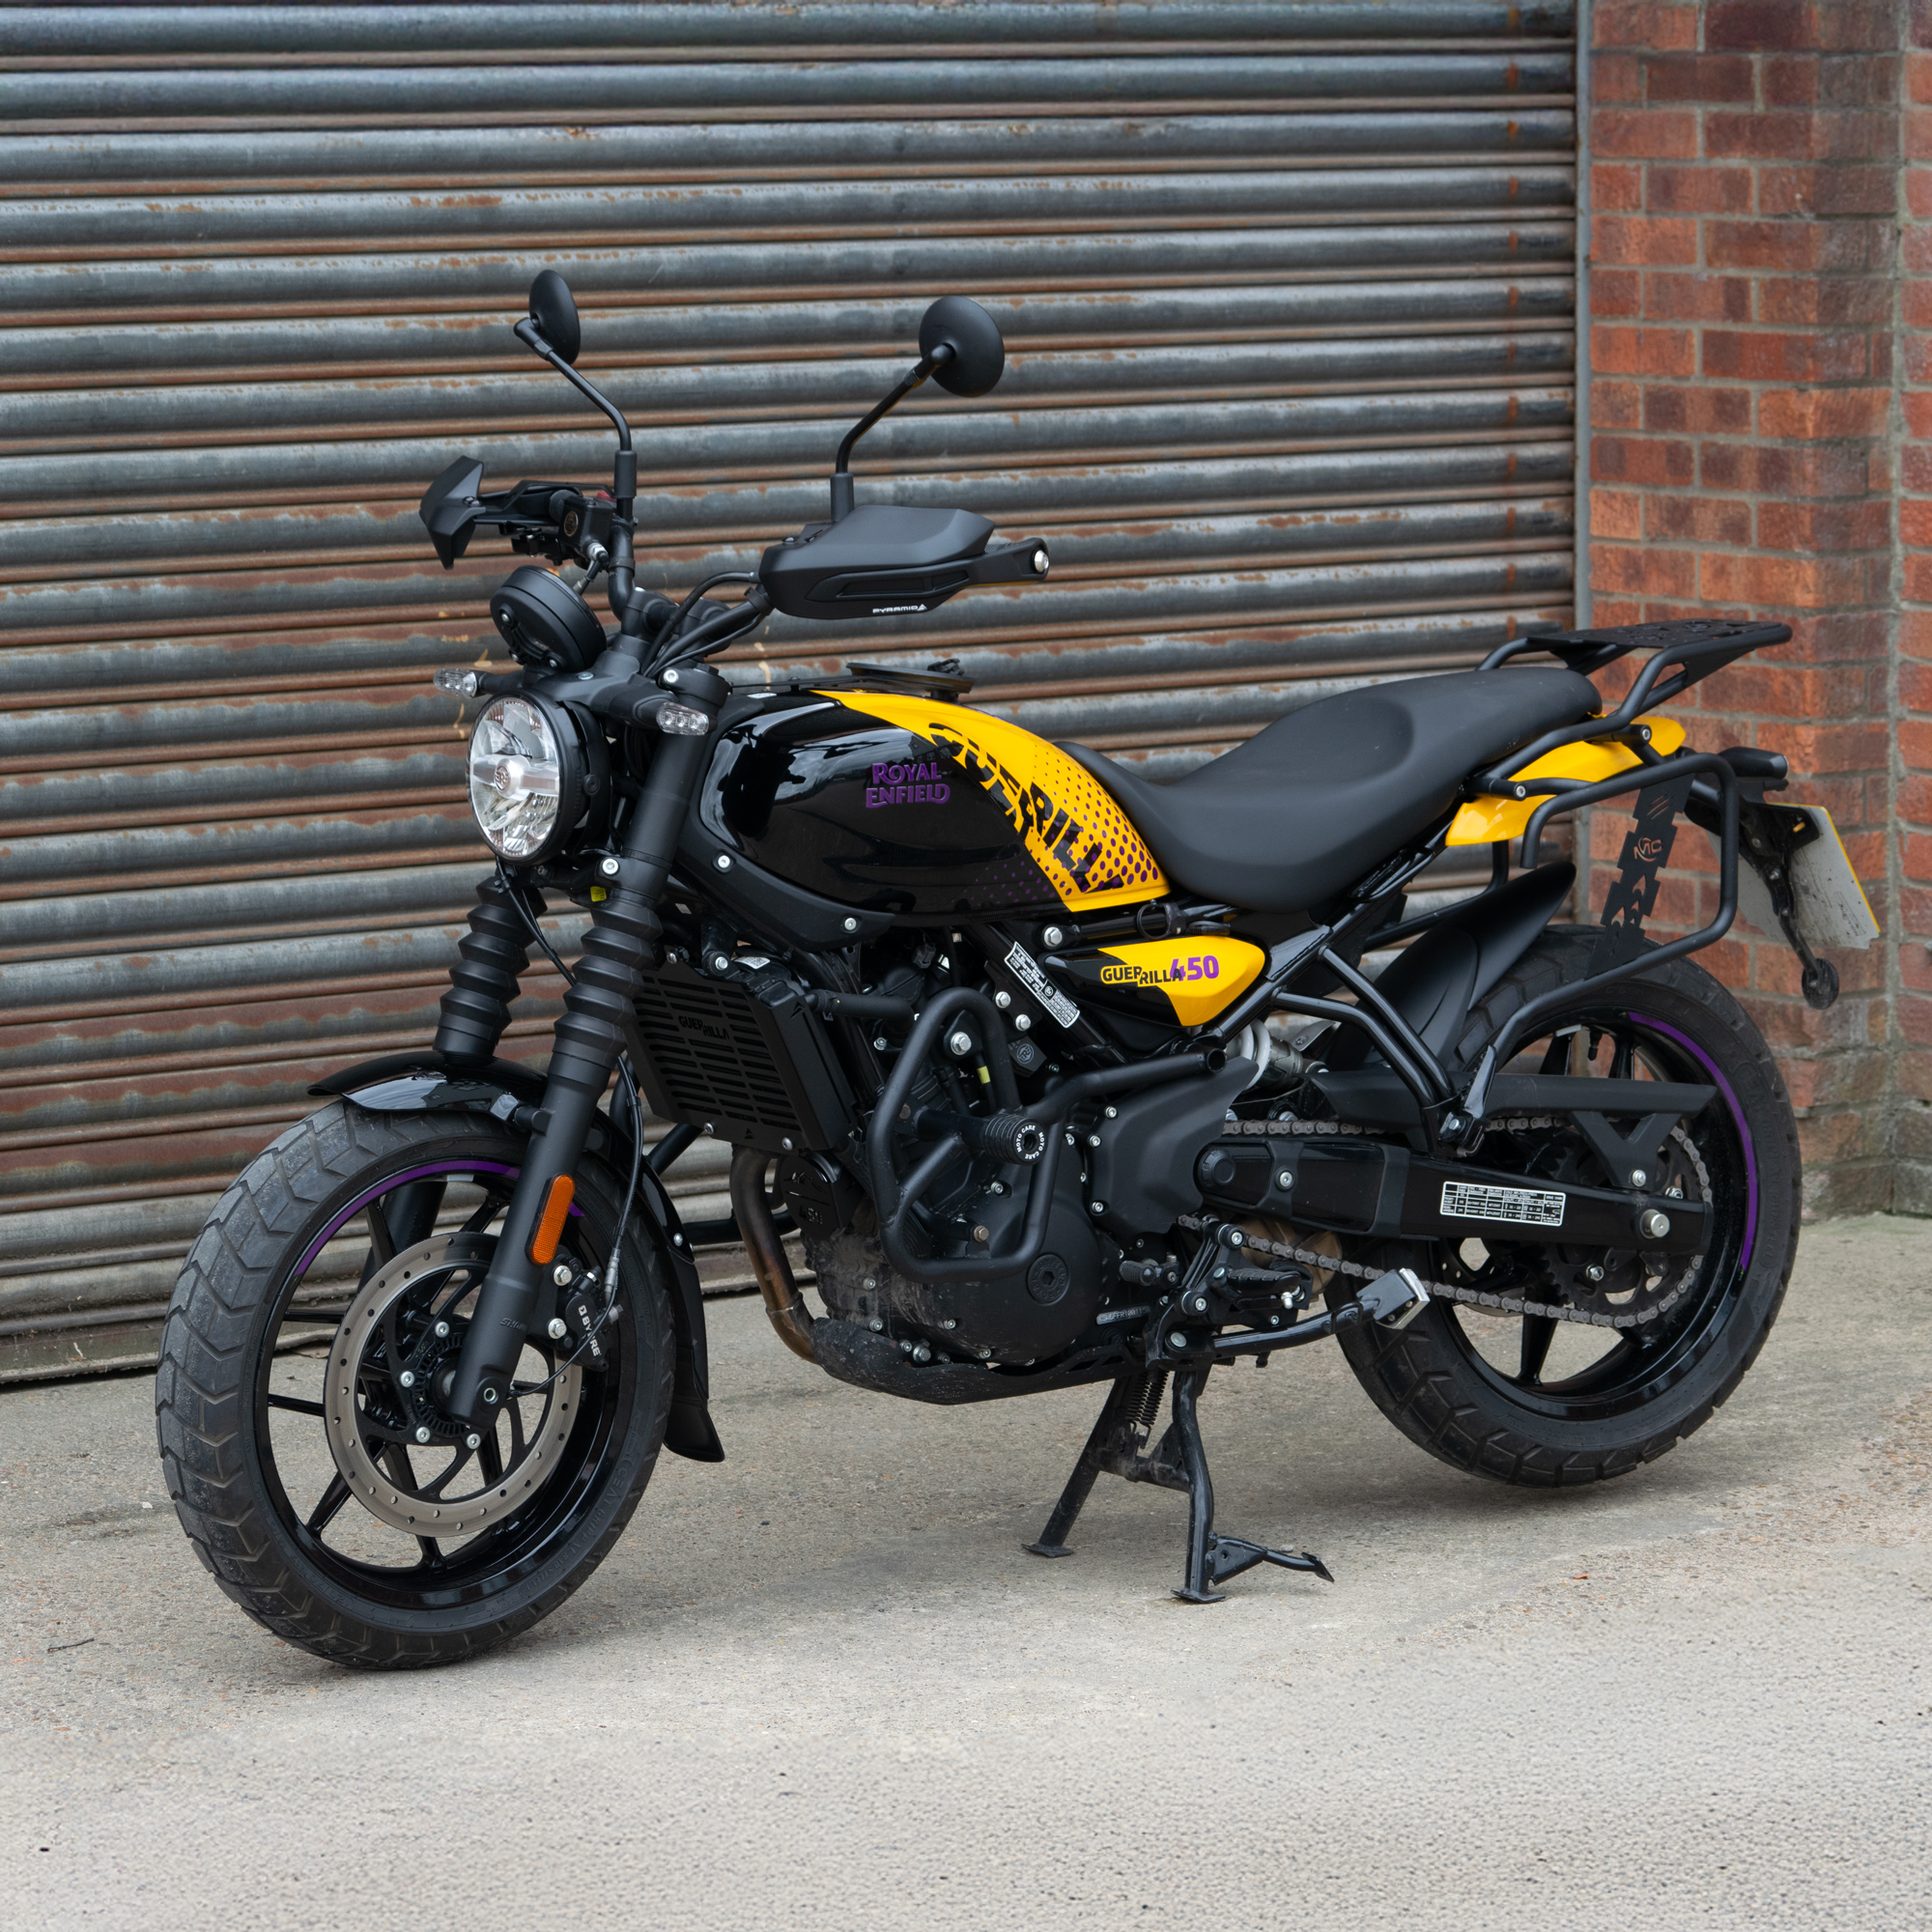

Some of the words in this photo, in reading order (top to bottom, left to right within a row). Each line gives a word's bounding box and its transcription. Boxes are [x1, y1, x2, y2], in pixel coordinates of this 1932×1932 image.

[872, 605, 918, 613] PYRAMID
[872, 762, 942, 785] ROYAL
[866, 782, 952, 809] ENFIELD
[1102, 966, 1182, 985] GUERRILLA
[1170, 954, 1220, 981] 450
[1021, 1124, 1036, 1133] CARE
[1025, 1151, 1039, 1159] CARE
